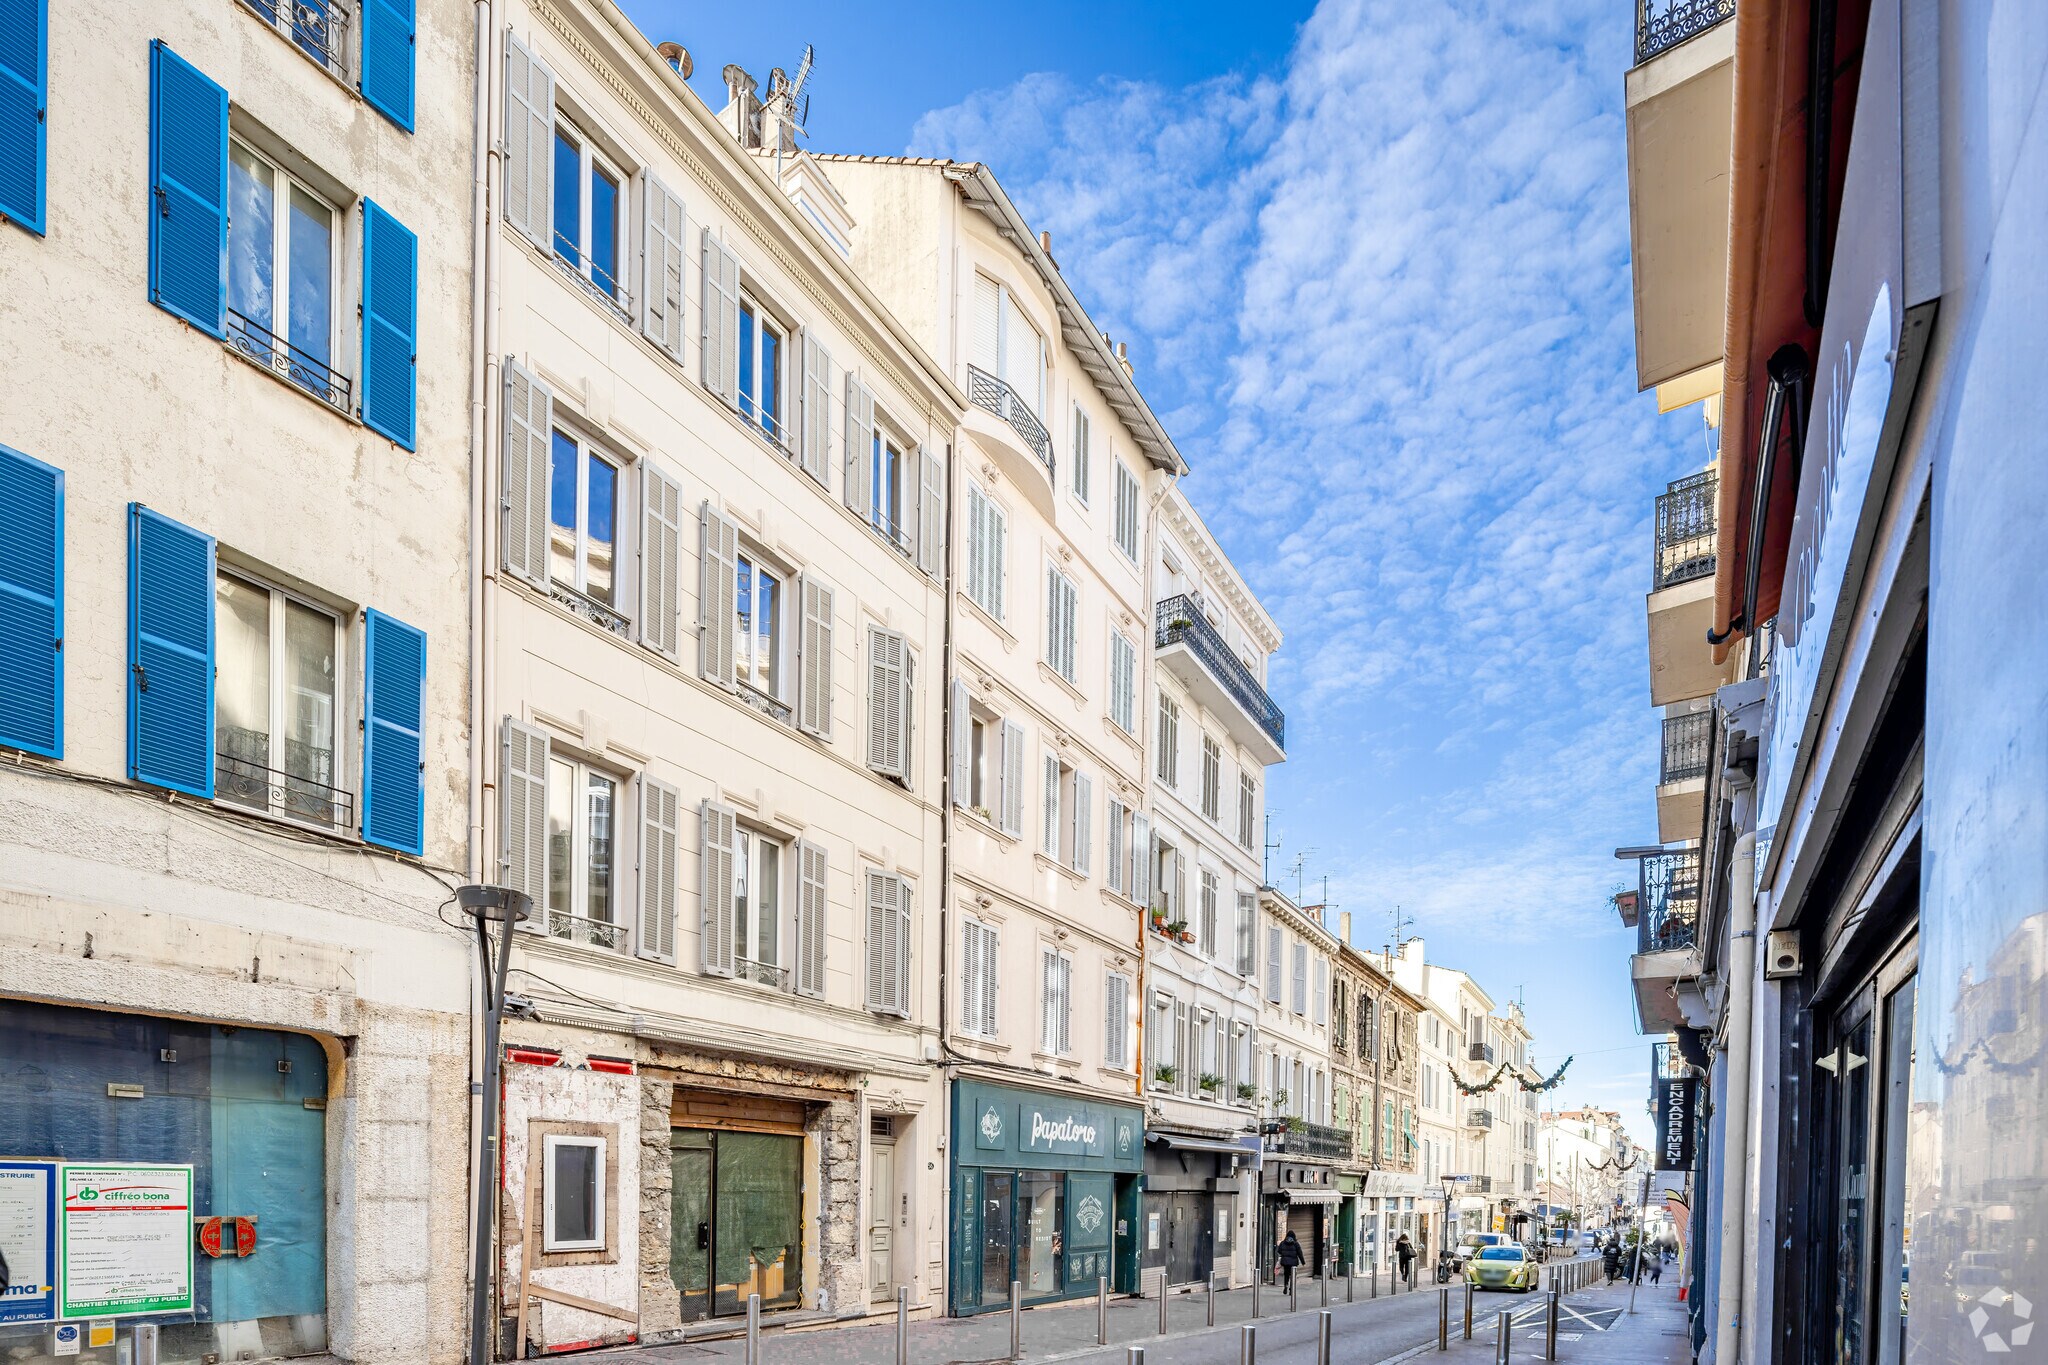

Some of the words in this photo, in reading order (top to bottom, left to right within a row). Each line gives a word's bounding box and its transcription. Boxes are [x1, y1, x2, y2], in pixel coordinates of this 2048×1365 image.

[1667, 1083, 1684, 1165] ENCADREMENT
[1031, 1112, 1096, 1148] Papatoro
[105, 1192, 141, 1200] ciffréo
[143, 1192, 170, 1200] bona
[5, 1284, 37, 1295] ma
[66, 1301, 109, 1309] CHANTIER
[17, 1312, 47, 1320] PUBLIC
